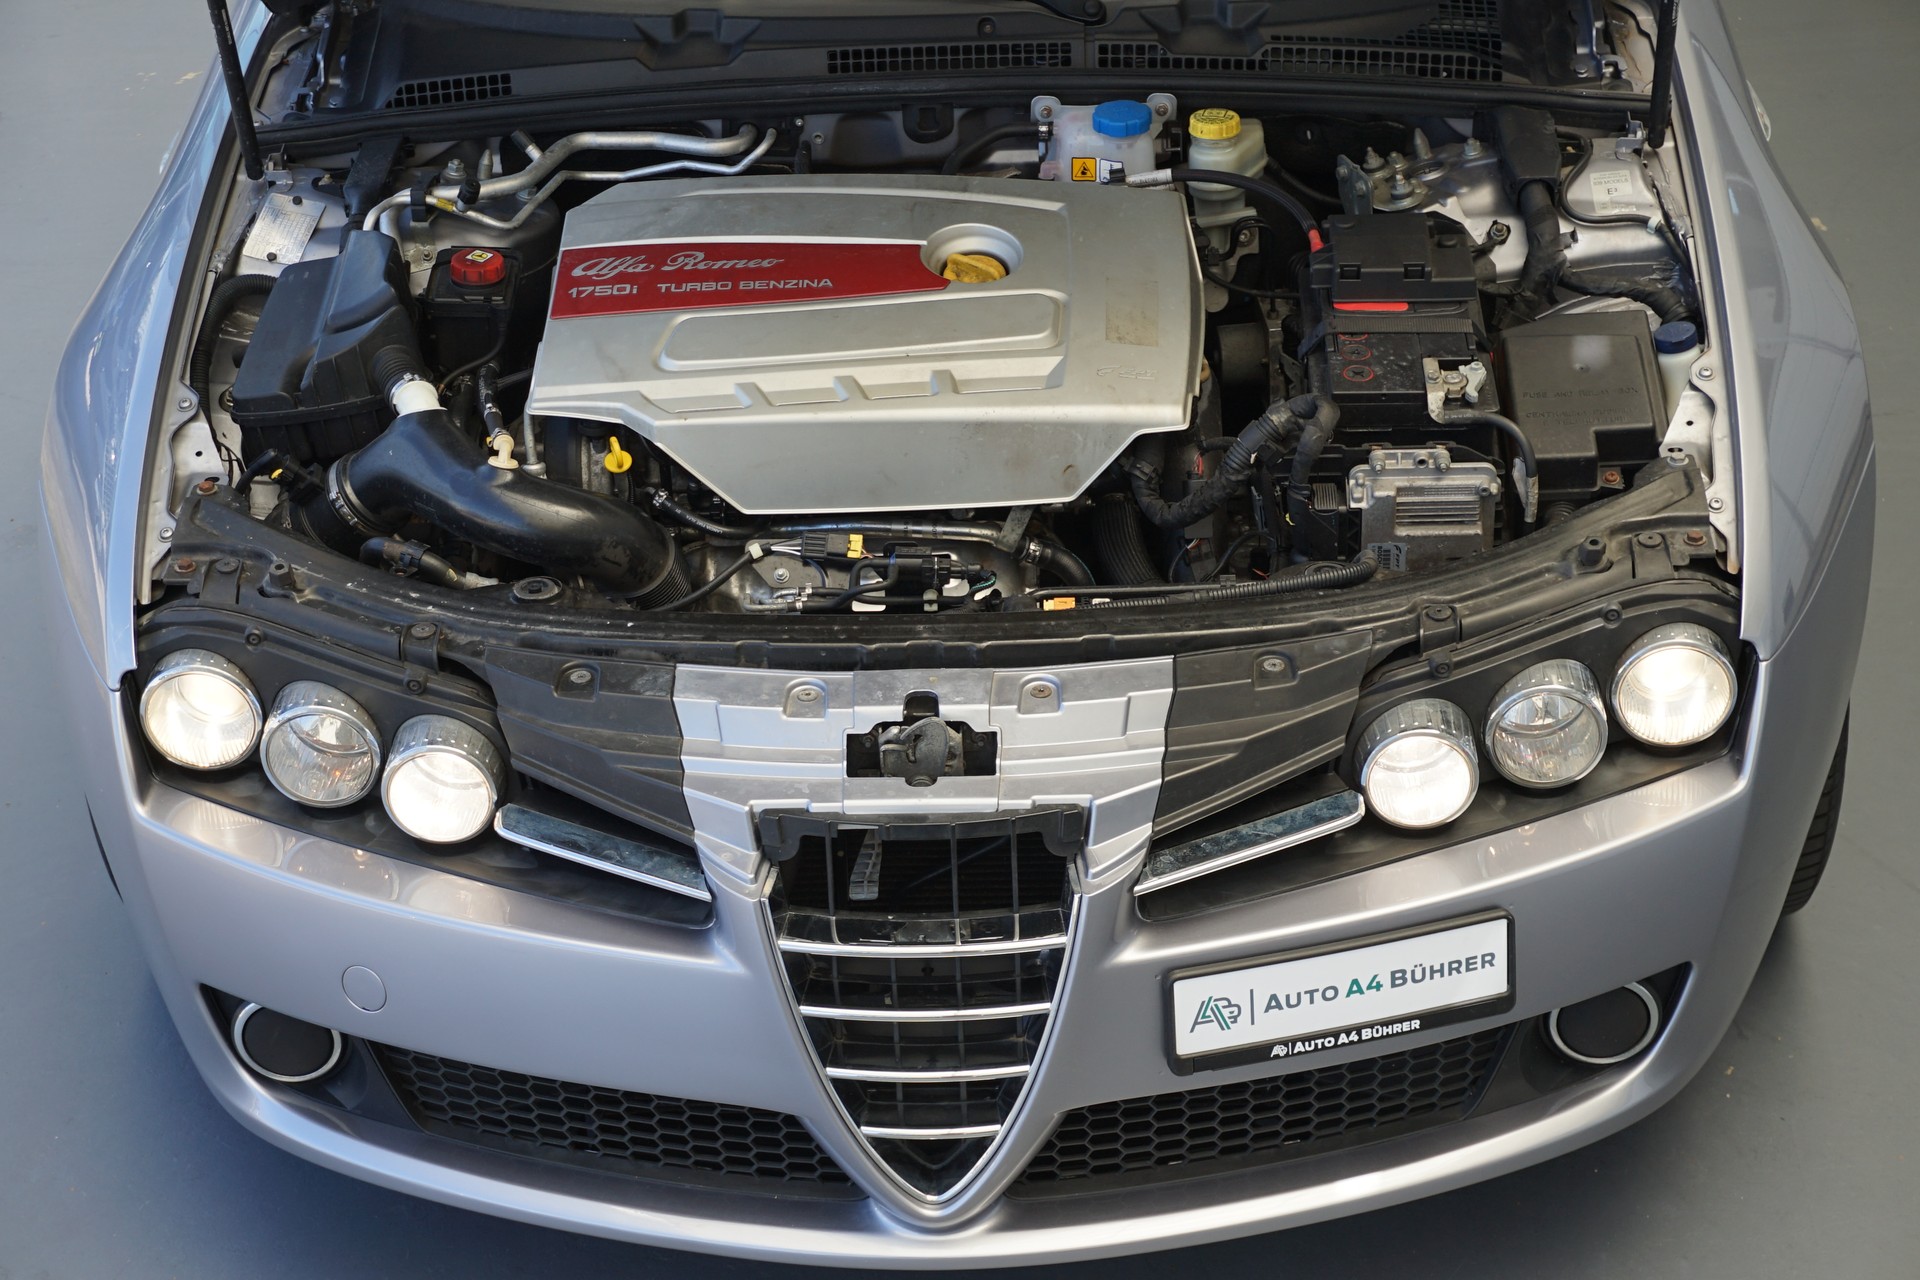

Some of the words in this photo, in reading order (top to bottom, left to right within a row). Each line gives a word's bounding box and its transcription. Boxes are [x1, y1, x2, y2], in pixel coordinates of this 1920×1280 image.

[571, 255, 655, 280] Alfa
[661, 251, 785, 271] Romeo
[568, 284, 638, 298] 1750i
[657, 281, 732, 293] TURBO
[739, 278, 833, 290] BENZINA
[1264, 985, 1339, 1013] AUTO
[1345, 973, 1383, 998] A4
[1390, 952, 1496, 988] BÜHRER
[1293, 1036, 1335, 1054] AUTO
[1337, 1030, 1359, 1045] A4
[1361, 1019, 1421, 1040] BÜHRER
